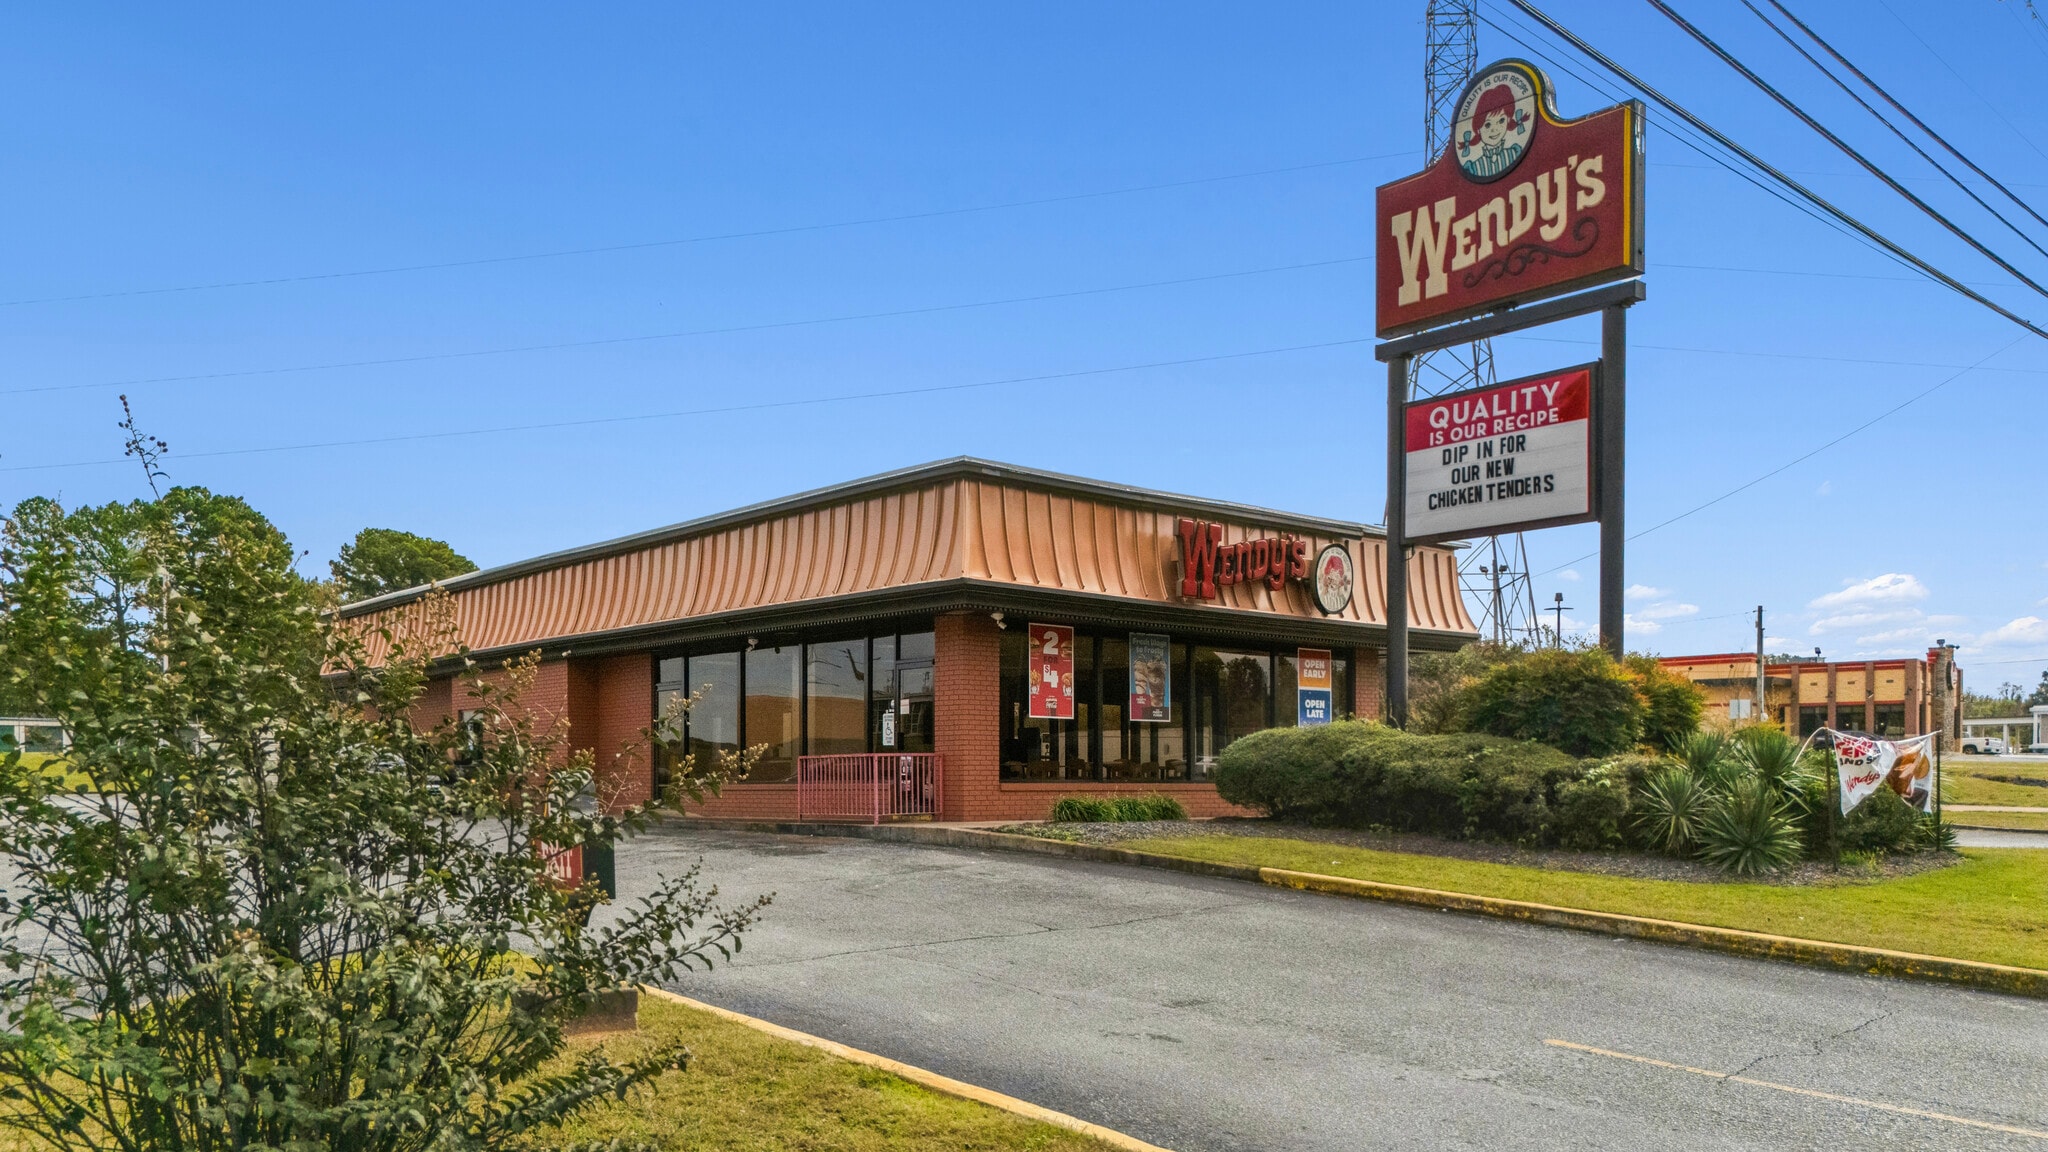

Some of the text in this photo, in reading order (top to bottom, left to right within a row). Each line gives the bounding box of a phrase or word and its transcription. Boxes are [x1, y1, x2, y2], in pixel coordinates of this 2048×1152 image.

[1462, 74, 1529, 117] QUALITY IS OUR RECIPE
[1429, 381, 1561, 429] QUALITY
[1429, 431, 1444, 446] IS
[1450, 422, 1487, 442] OUR
[1442, 434, 1526, 466] DIP IN FOR
[1451, 458, 1515, 485] OUR NEW
[1428, 474, 1554, 511] CHICKEN TENDERS
[1043, 630, 1059, 655] 2
[1043, 656, 1059, 664] FOR
[1304, 660, 1325, 669] OPEN
[1303, 669, 1326, 679] EARLY
[1305, 699, 1325, 709] OPEN
[1306, 709, 1324, 719] LATE
